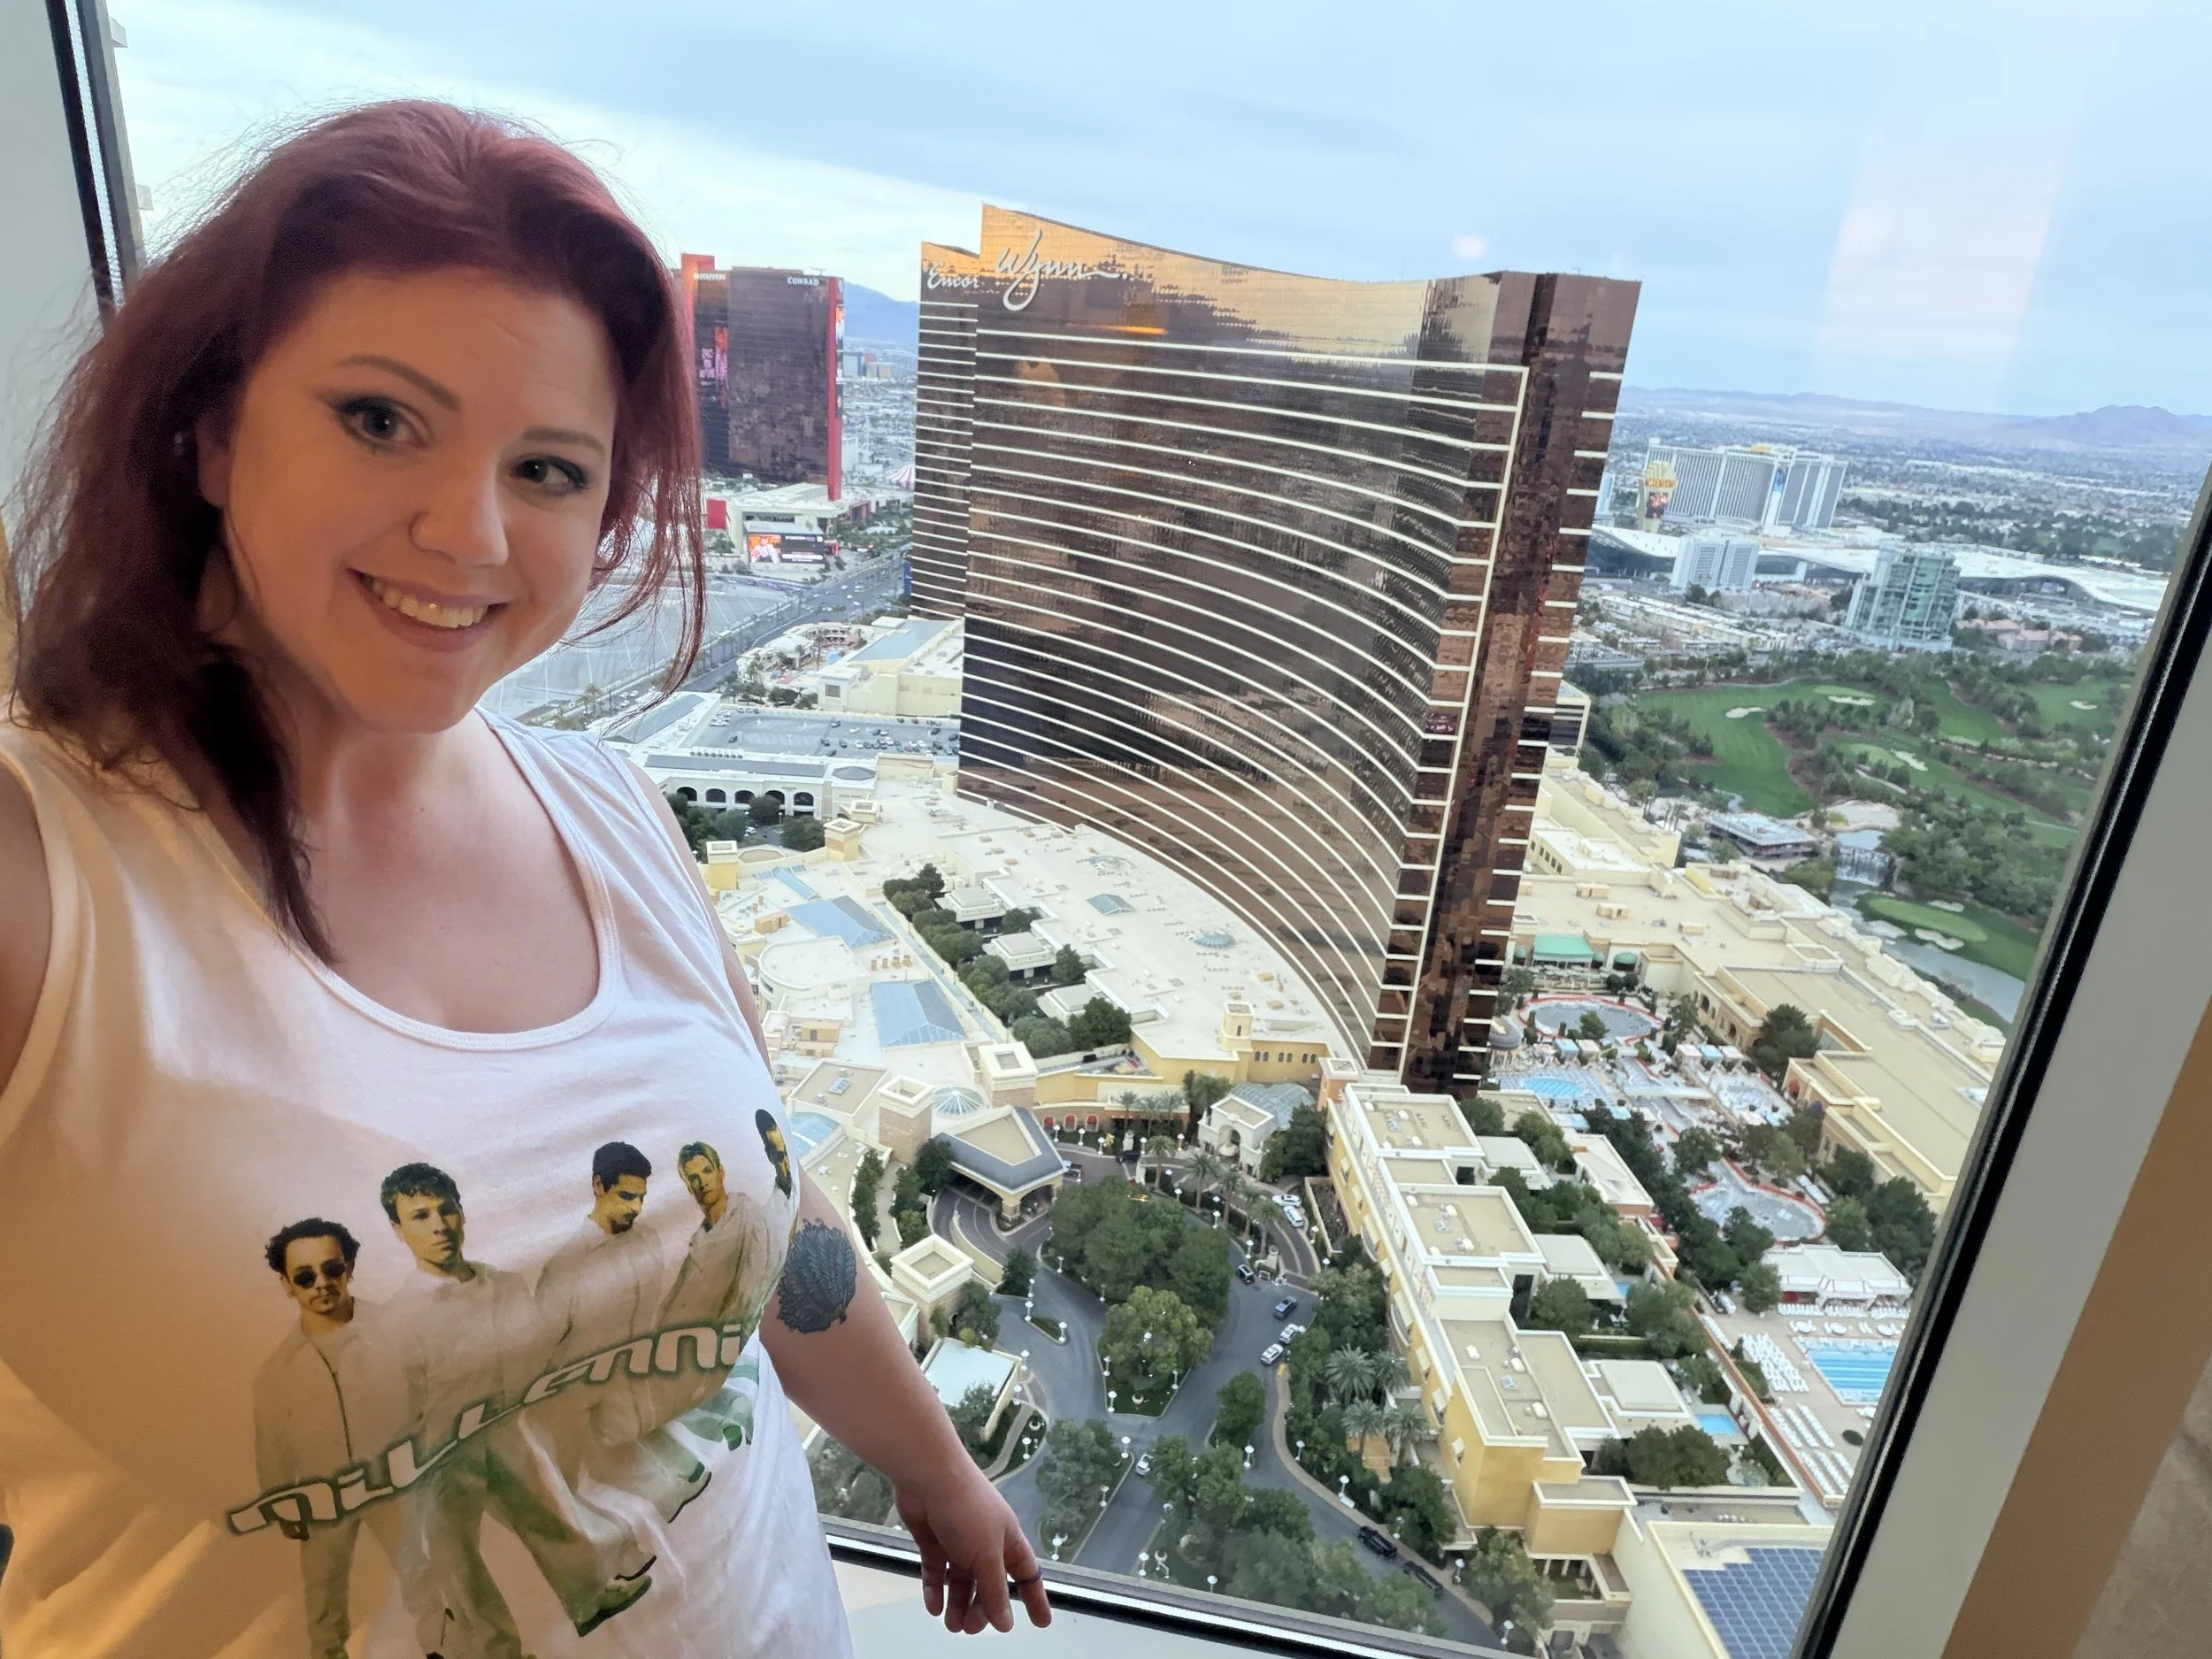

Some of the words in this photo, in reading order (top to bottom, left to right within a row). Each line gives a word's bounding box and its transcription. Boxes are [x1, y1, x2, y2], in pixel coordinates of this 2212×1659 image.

[787, 276, 820, 286] CONRAD
[926, 262, 979, 289] Encor
[227, 1323, 743, 1535] millenni
